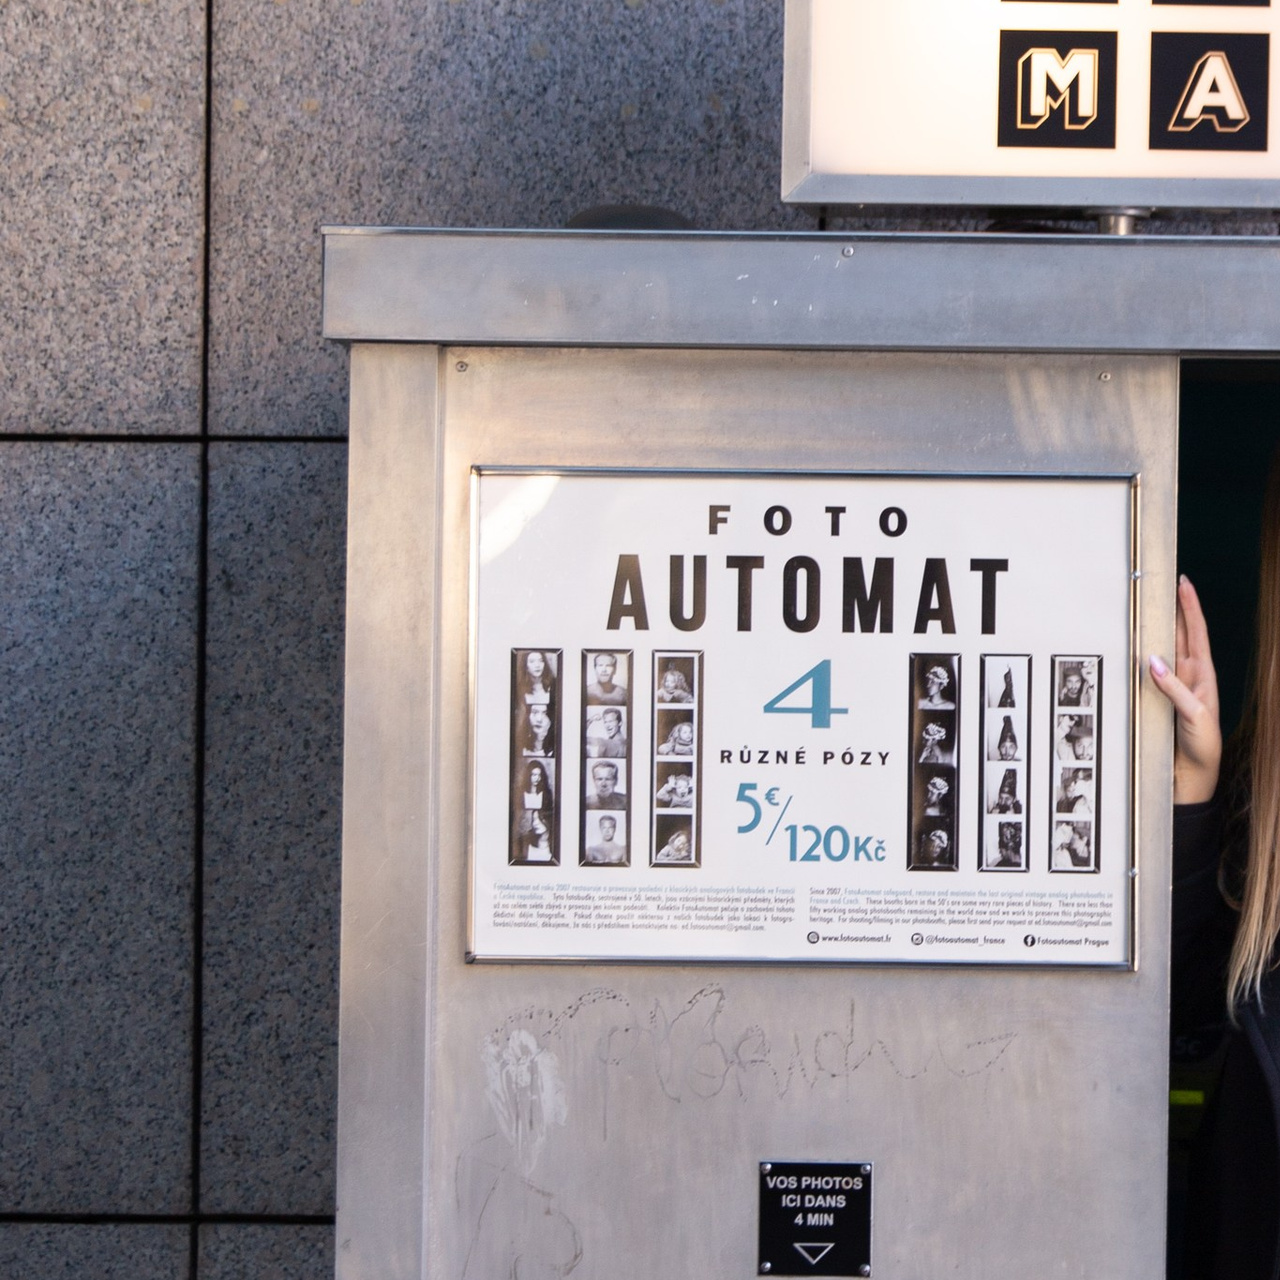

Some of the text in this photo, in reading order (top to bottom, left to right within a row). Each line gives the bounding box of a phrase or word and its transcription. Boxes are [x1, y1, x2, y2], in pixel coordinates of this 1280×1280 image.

[708, 504, 909, 537] FOTO
[606, 554, 1009, 636] AUTOMAT
[763, 658, 849, 729] 4
[720, 744, 891, 766] RŮZNÉ PÓZY
[822, 933, 891, 943] www.fotoautomat.fr
[1085, 936, 1109, 948] Prague
[766, 1176, 863, 1190] VOS PHOTOS
[781, 1194, 847, 1208] ICI DANS
[794, 1213, 834, 1227] 4 MIN
